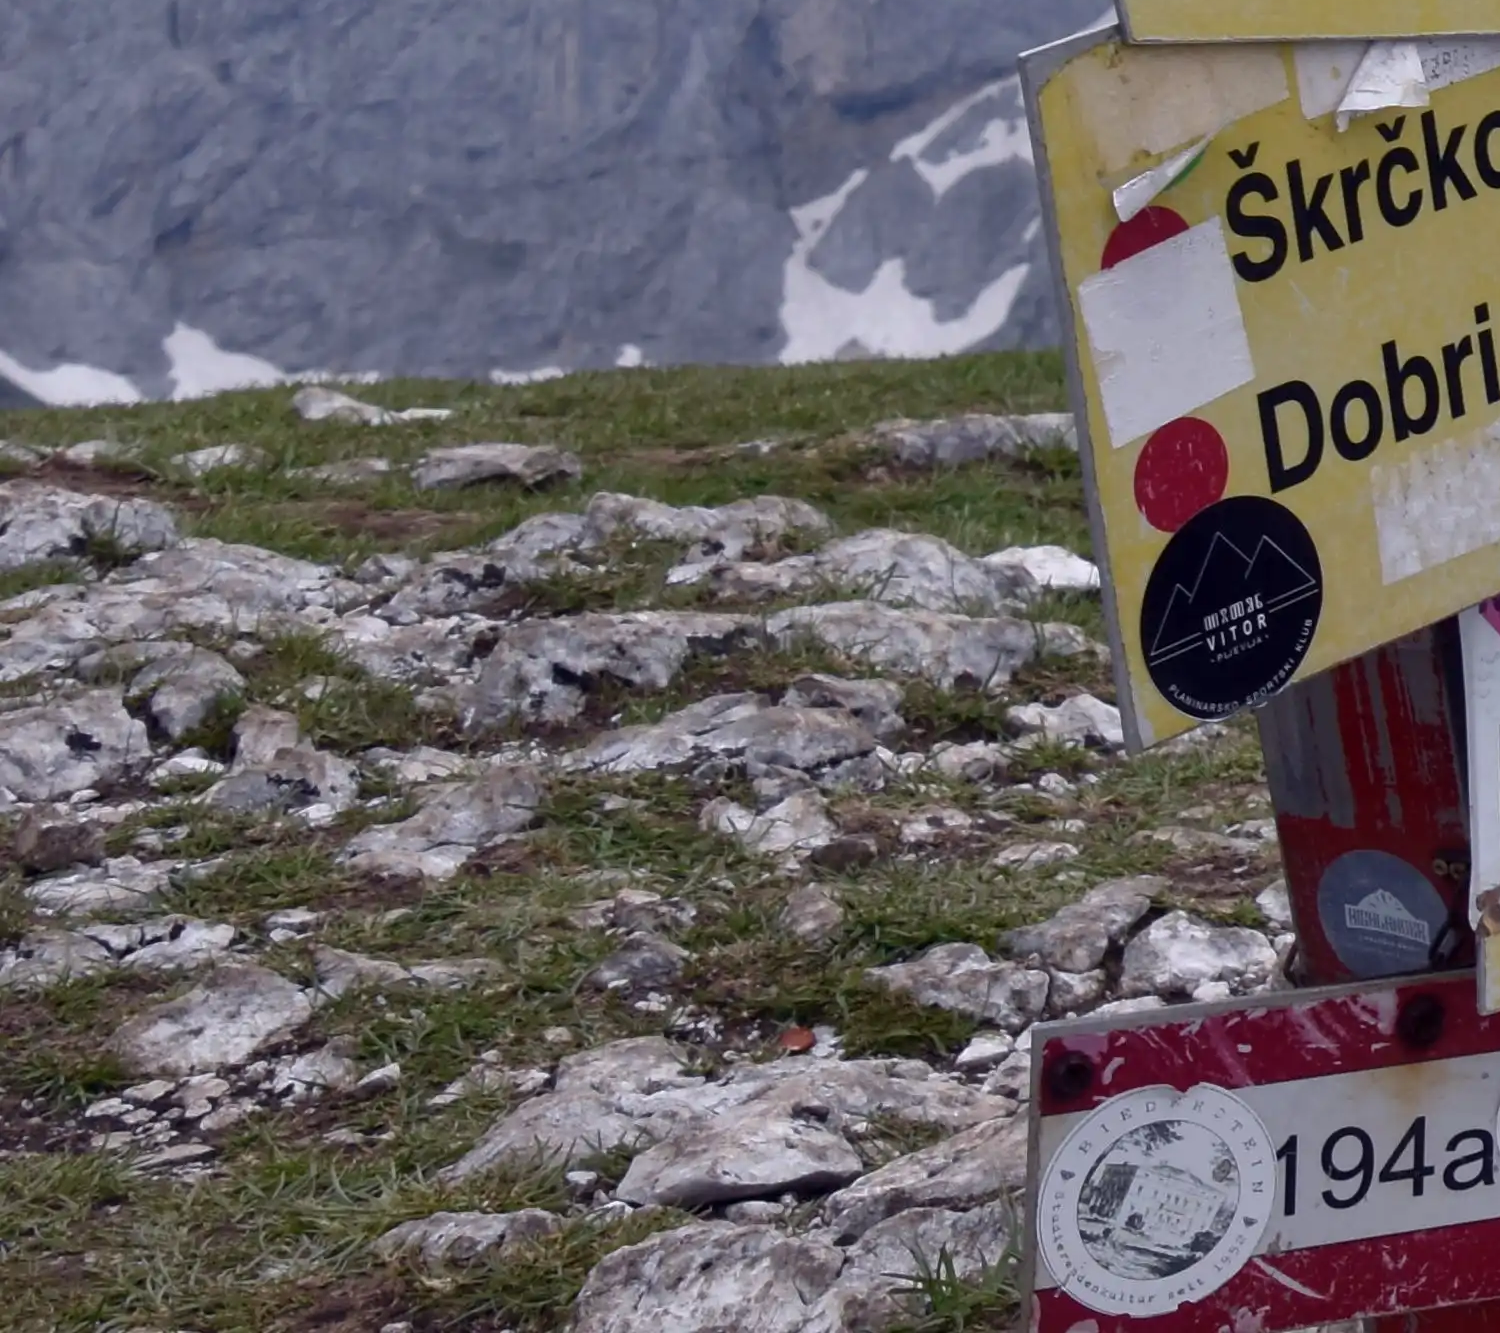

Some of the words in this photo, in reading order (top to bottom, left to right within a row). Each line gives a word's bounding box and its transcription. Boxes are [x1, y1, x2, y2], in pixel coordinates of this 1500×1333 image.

[1167, 683, 1240, 714] PLANINARSKO
[1245, 657, 1296, 706] SPORTSKI
[1294, 618, 1314, 653] KLUB
[1205, 613, 1269, 652] VITOR
[1275, 1114, 1499, 1218] 194a
